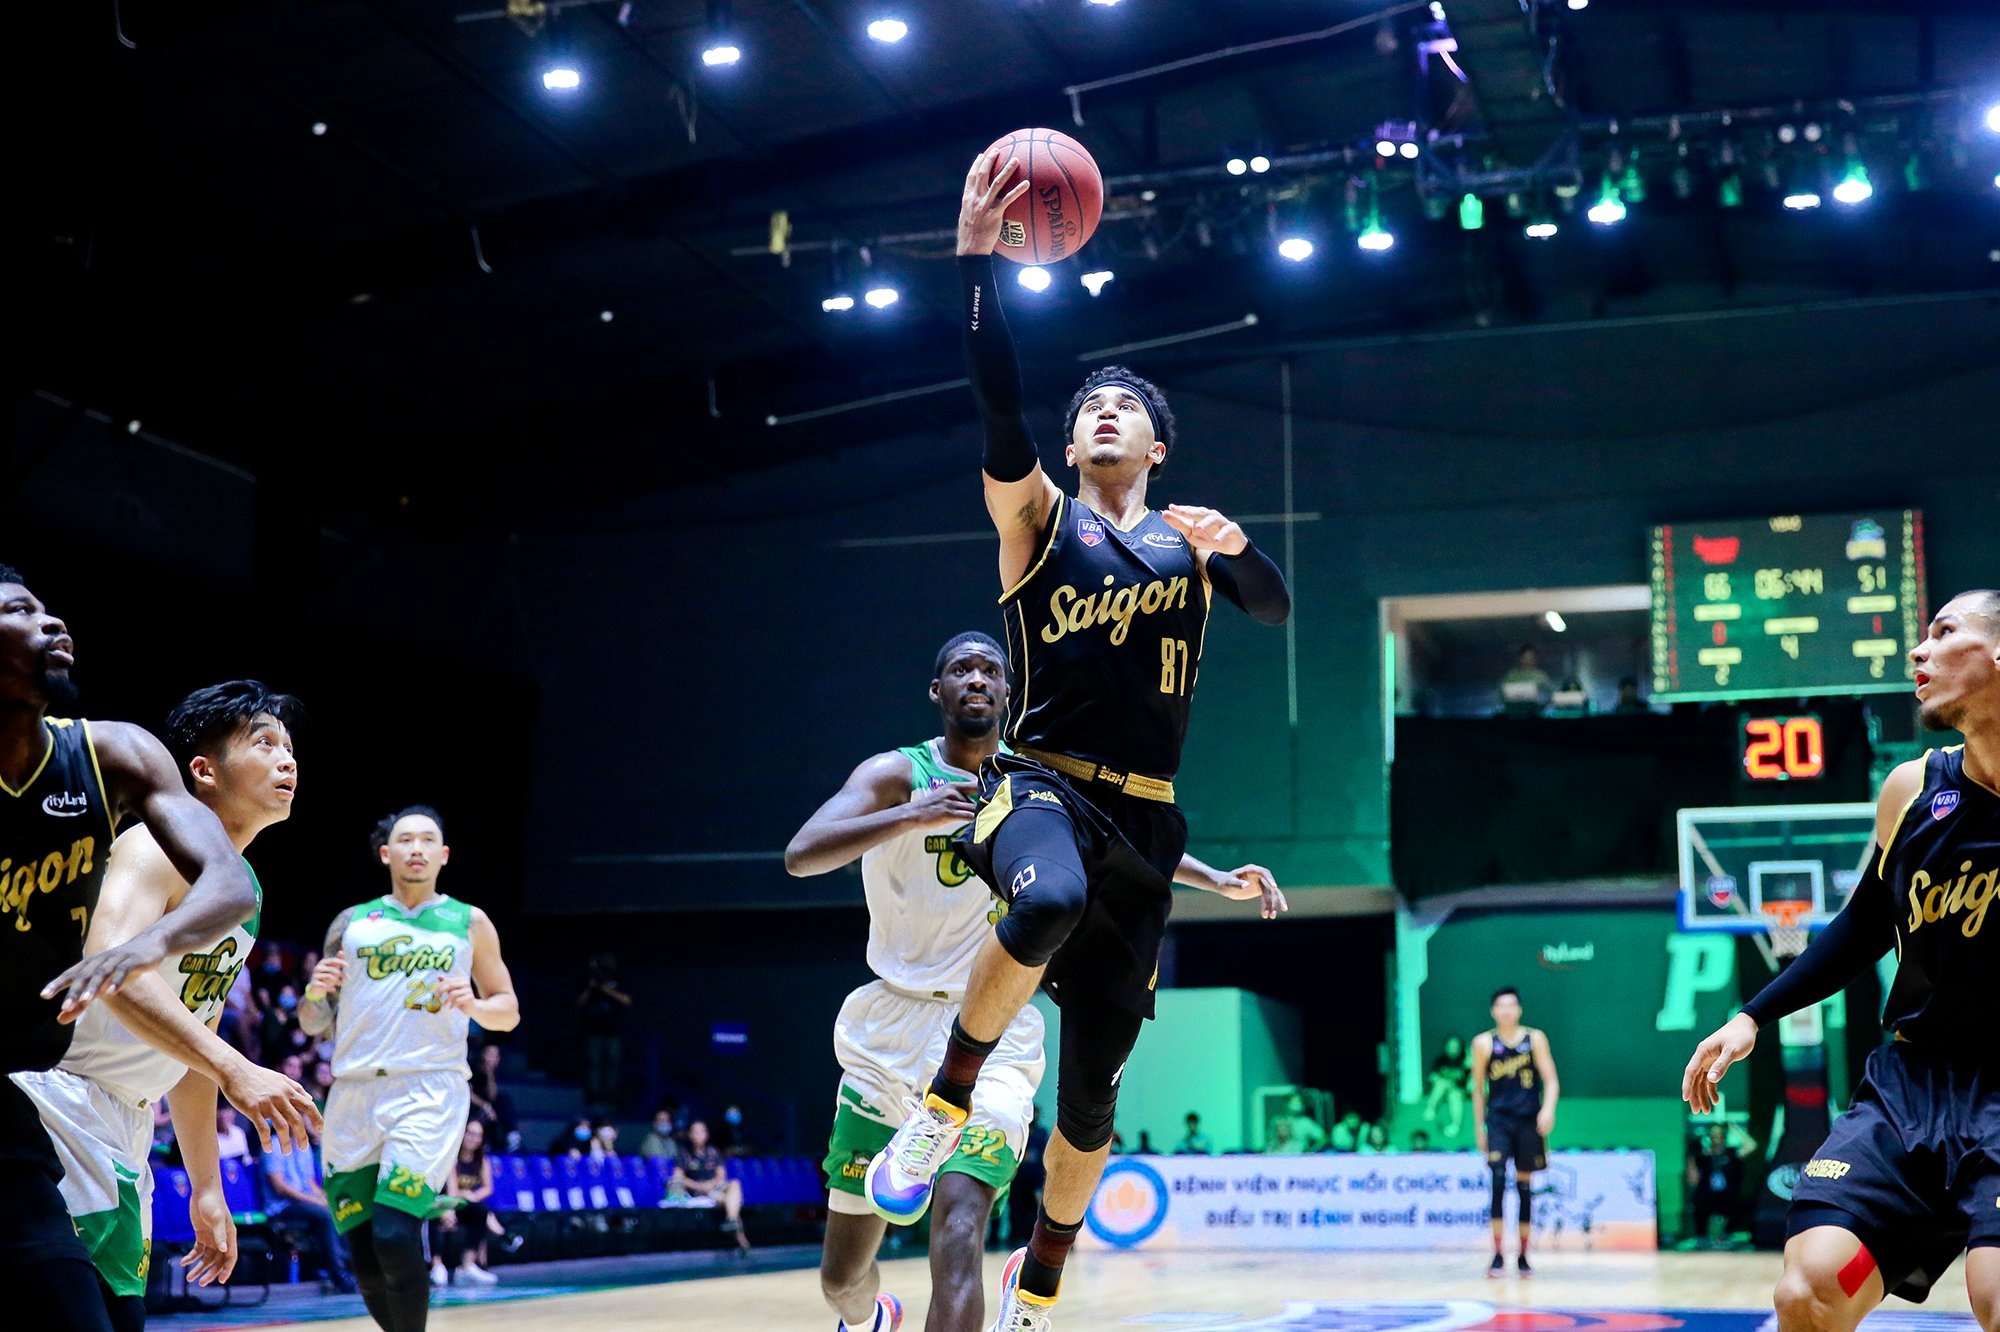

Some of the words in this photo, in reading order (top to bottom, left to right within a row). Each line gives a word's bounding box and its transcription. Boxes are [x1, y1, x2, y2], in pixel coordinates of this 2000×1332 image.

[1009, 221, 1025, 247] VBA
[1082, 521, 1104, 533] VBA
[1041, 574, 1188, 646] Saigon
[1160, 637, 1188, 696] 87
[1745, 717, 1824, 780] 20
[1098, 769, 1126, 785] SGH
[1937, 794, 1957, 805] VBA
[926, 838, 947, 850] CAN
[0, 836, 95, 932] igon
[1908, 860, 2000, 938] Saig
[366, 935, 454, 980] Catfish
[404, 981, 442, 1013] 23
[961, 1126, 1007, 1166] 32
[389, 1166, 425, 1198] 23
